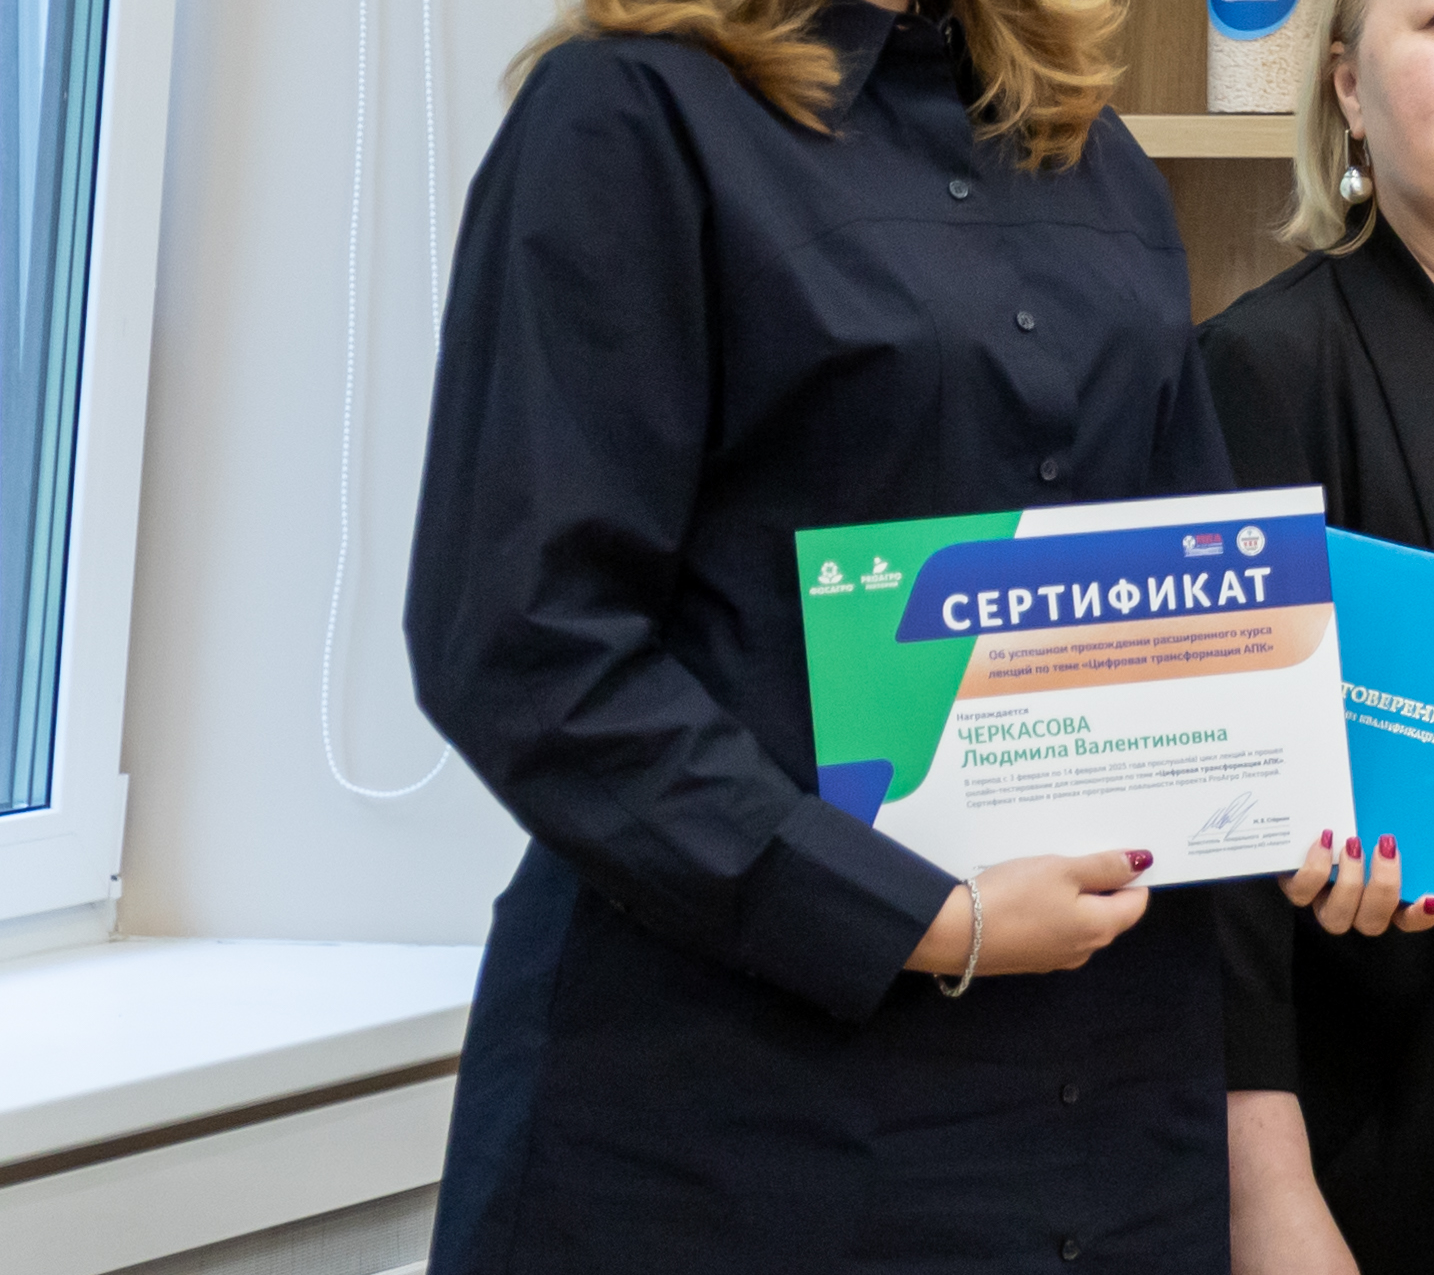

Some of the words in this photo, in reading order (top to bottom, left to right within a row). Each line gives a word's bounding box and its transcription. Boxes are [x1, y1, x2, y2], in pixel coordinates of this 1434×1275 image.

[941, 566, 1272, 632] СЕРТИФИКАТ
[987, 664, 1033, 680] лекций
[1034, 664, 1051, 675] по
[1052, 662, 1080, 673] теме
[1080, 655, 1148, 671] «Цифровая
[1150, 646, 1242, 666] трансформация
[1242, 641, 1275, 655] АПК»
[988, 649, 1007, 662] Об
[1007, 644, 1069, 663] успешном
[1069, 637, 1152, 656] прохождении
[1152, 629, 1238, 649] расширенного
[1239, 626, 1273, 640] курса
[955, 707, 1030, 723] Награждается
[957, 715, 1092, 746] ЧЕРКАСОВА
[960, 743, 1070, 769] Людмила
[1073, 727, 1229, 757] Валентиновна
